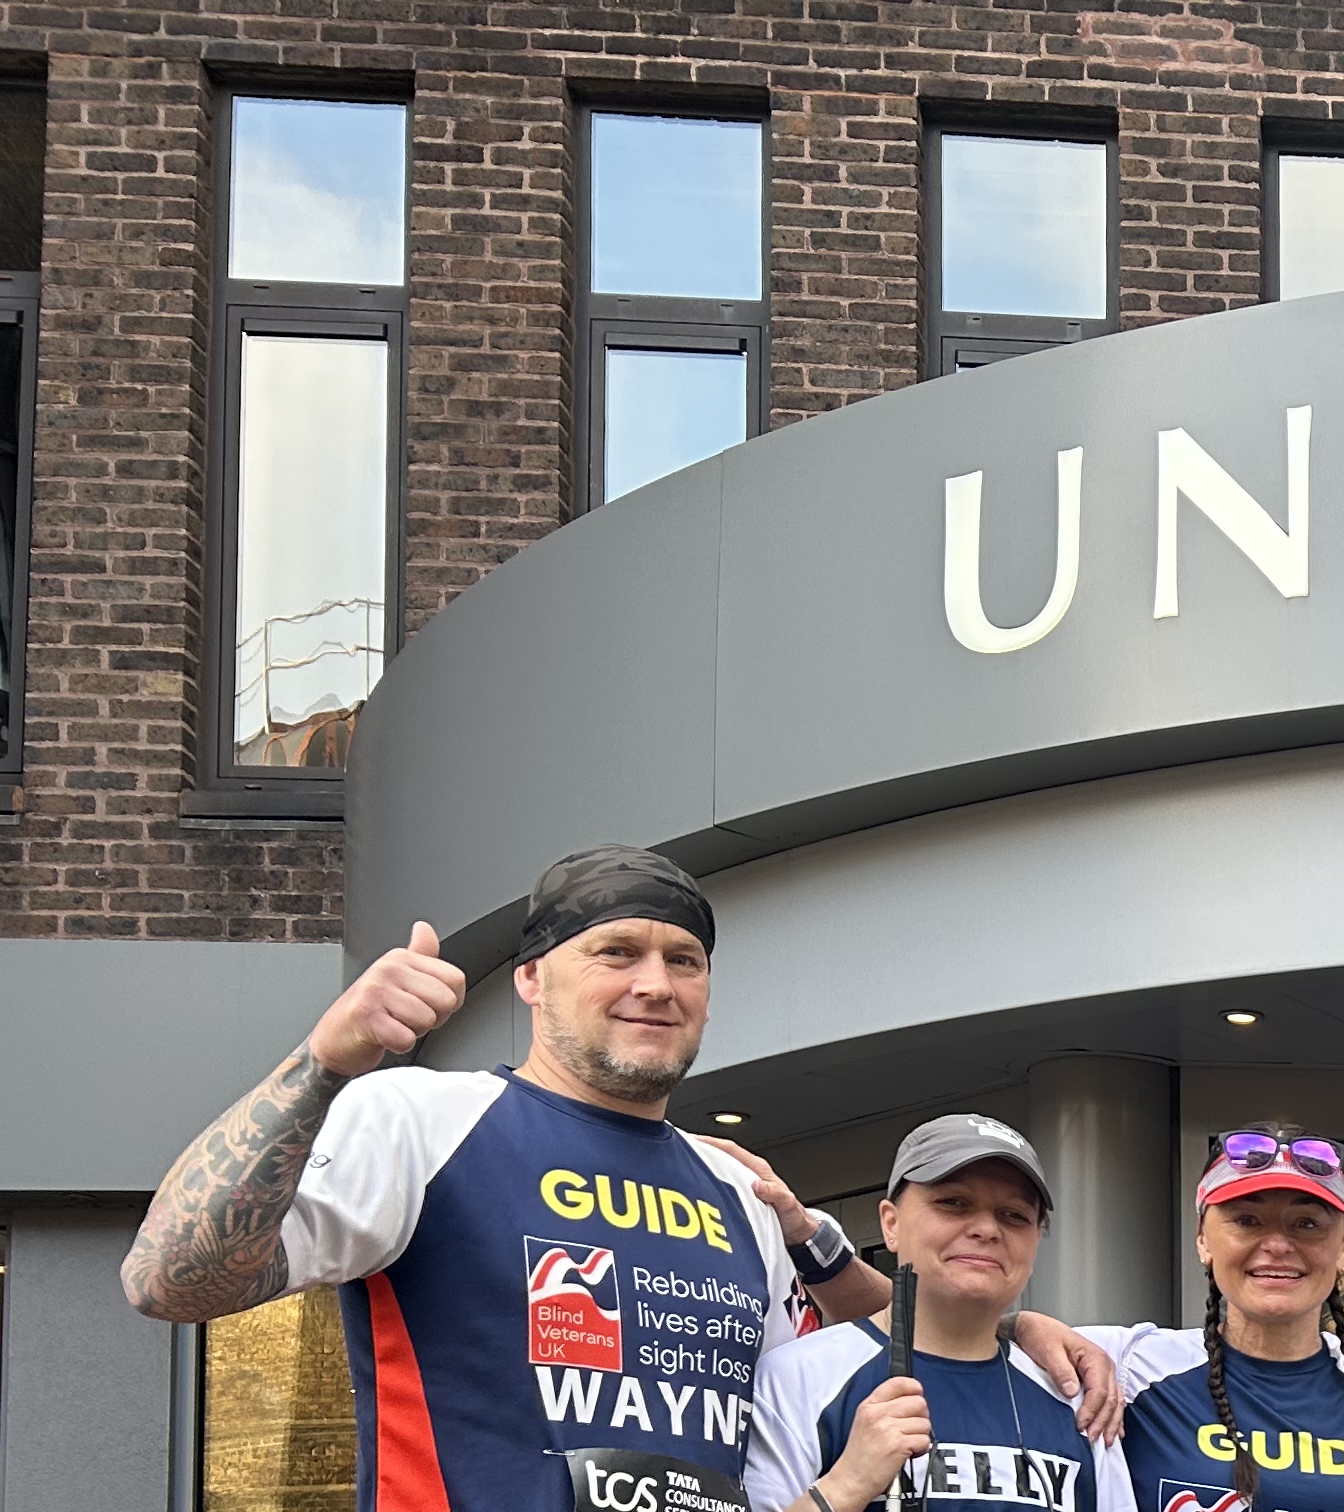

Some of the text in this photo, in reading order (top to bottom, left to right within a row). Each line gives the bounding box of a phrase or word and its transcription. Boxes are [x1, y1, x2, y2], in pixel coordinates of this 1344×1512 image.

[540, 1169, 732, 1253] GUIDE
[632, 1267, 764, 1322] Rebuilding
[538, 1306, 583, 1325] Blind
[638, 1301, 761, 1348] lives after
[538, 1325, 614, 1348] Veterans
[538, 1344, 566, 1358] UK
[639, 1344, 750, 1383] sight loss
[536, 1366, 752, 1452] WAYNE
[666, 1471, 700, 1492] TATA
